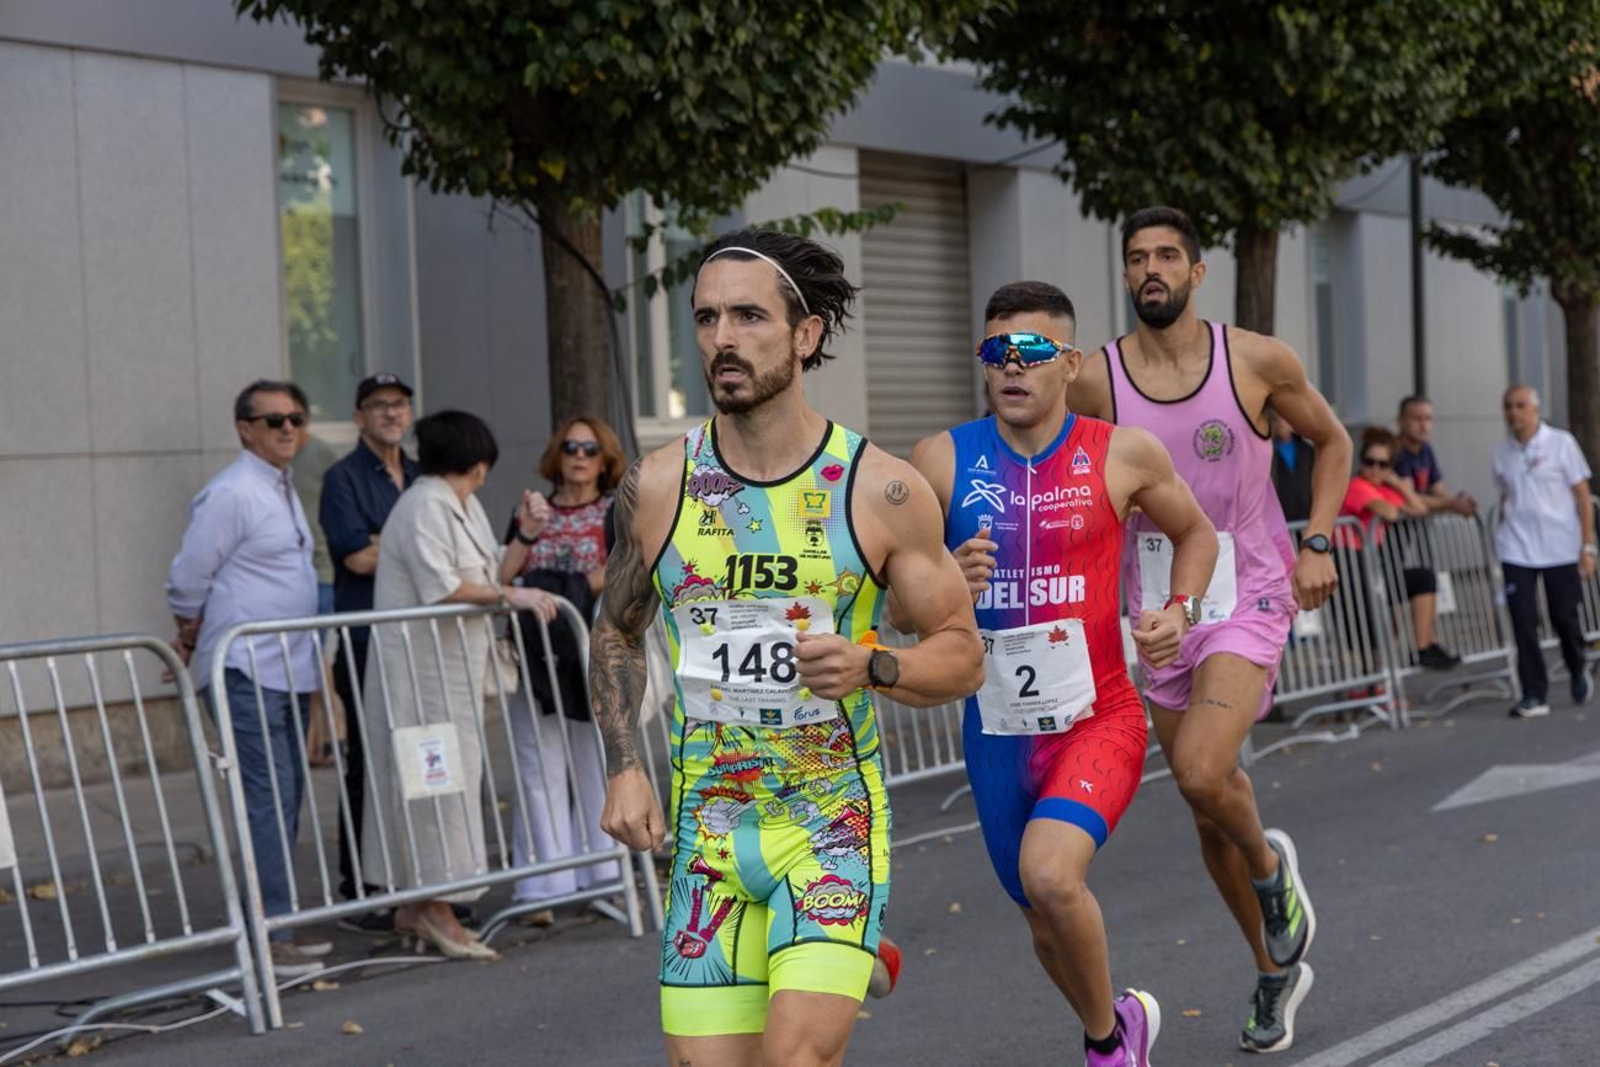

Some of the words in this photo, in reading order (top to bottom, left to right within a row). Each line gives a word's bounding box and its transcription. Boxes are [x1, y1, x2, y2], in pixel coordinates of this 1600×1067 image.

[1010, 490, 1026, 506] la
[1031, 486, 1092, 511] palma
[1038, 499, 1093, 512] cooperativa
[697, 528, 735, 537] RAFITA
[1145, 537, 1163, 552] 37
[725, 554, 798, 591] 1153
[1029, 575, 1086, 607] SUR
[689, 607, 719, 626] 37
[712, 641, 797, 684] 148
[1014, 664, 1040, 699] 2
[793, 705, 821, 721] Forus
[803, 893, 866, 912] BOOM!
